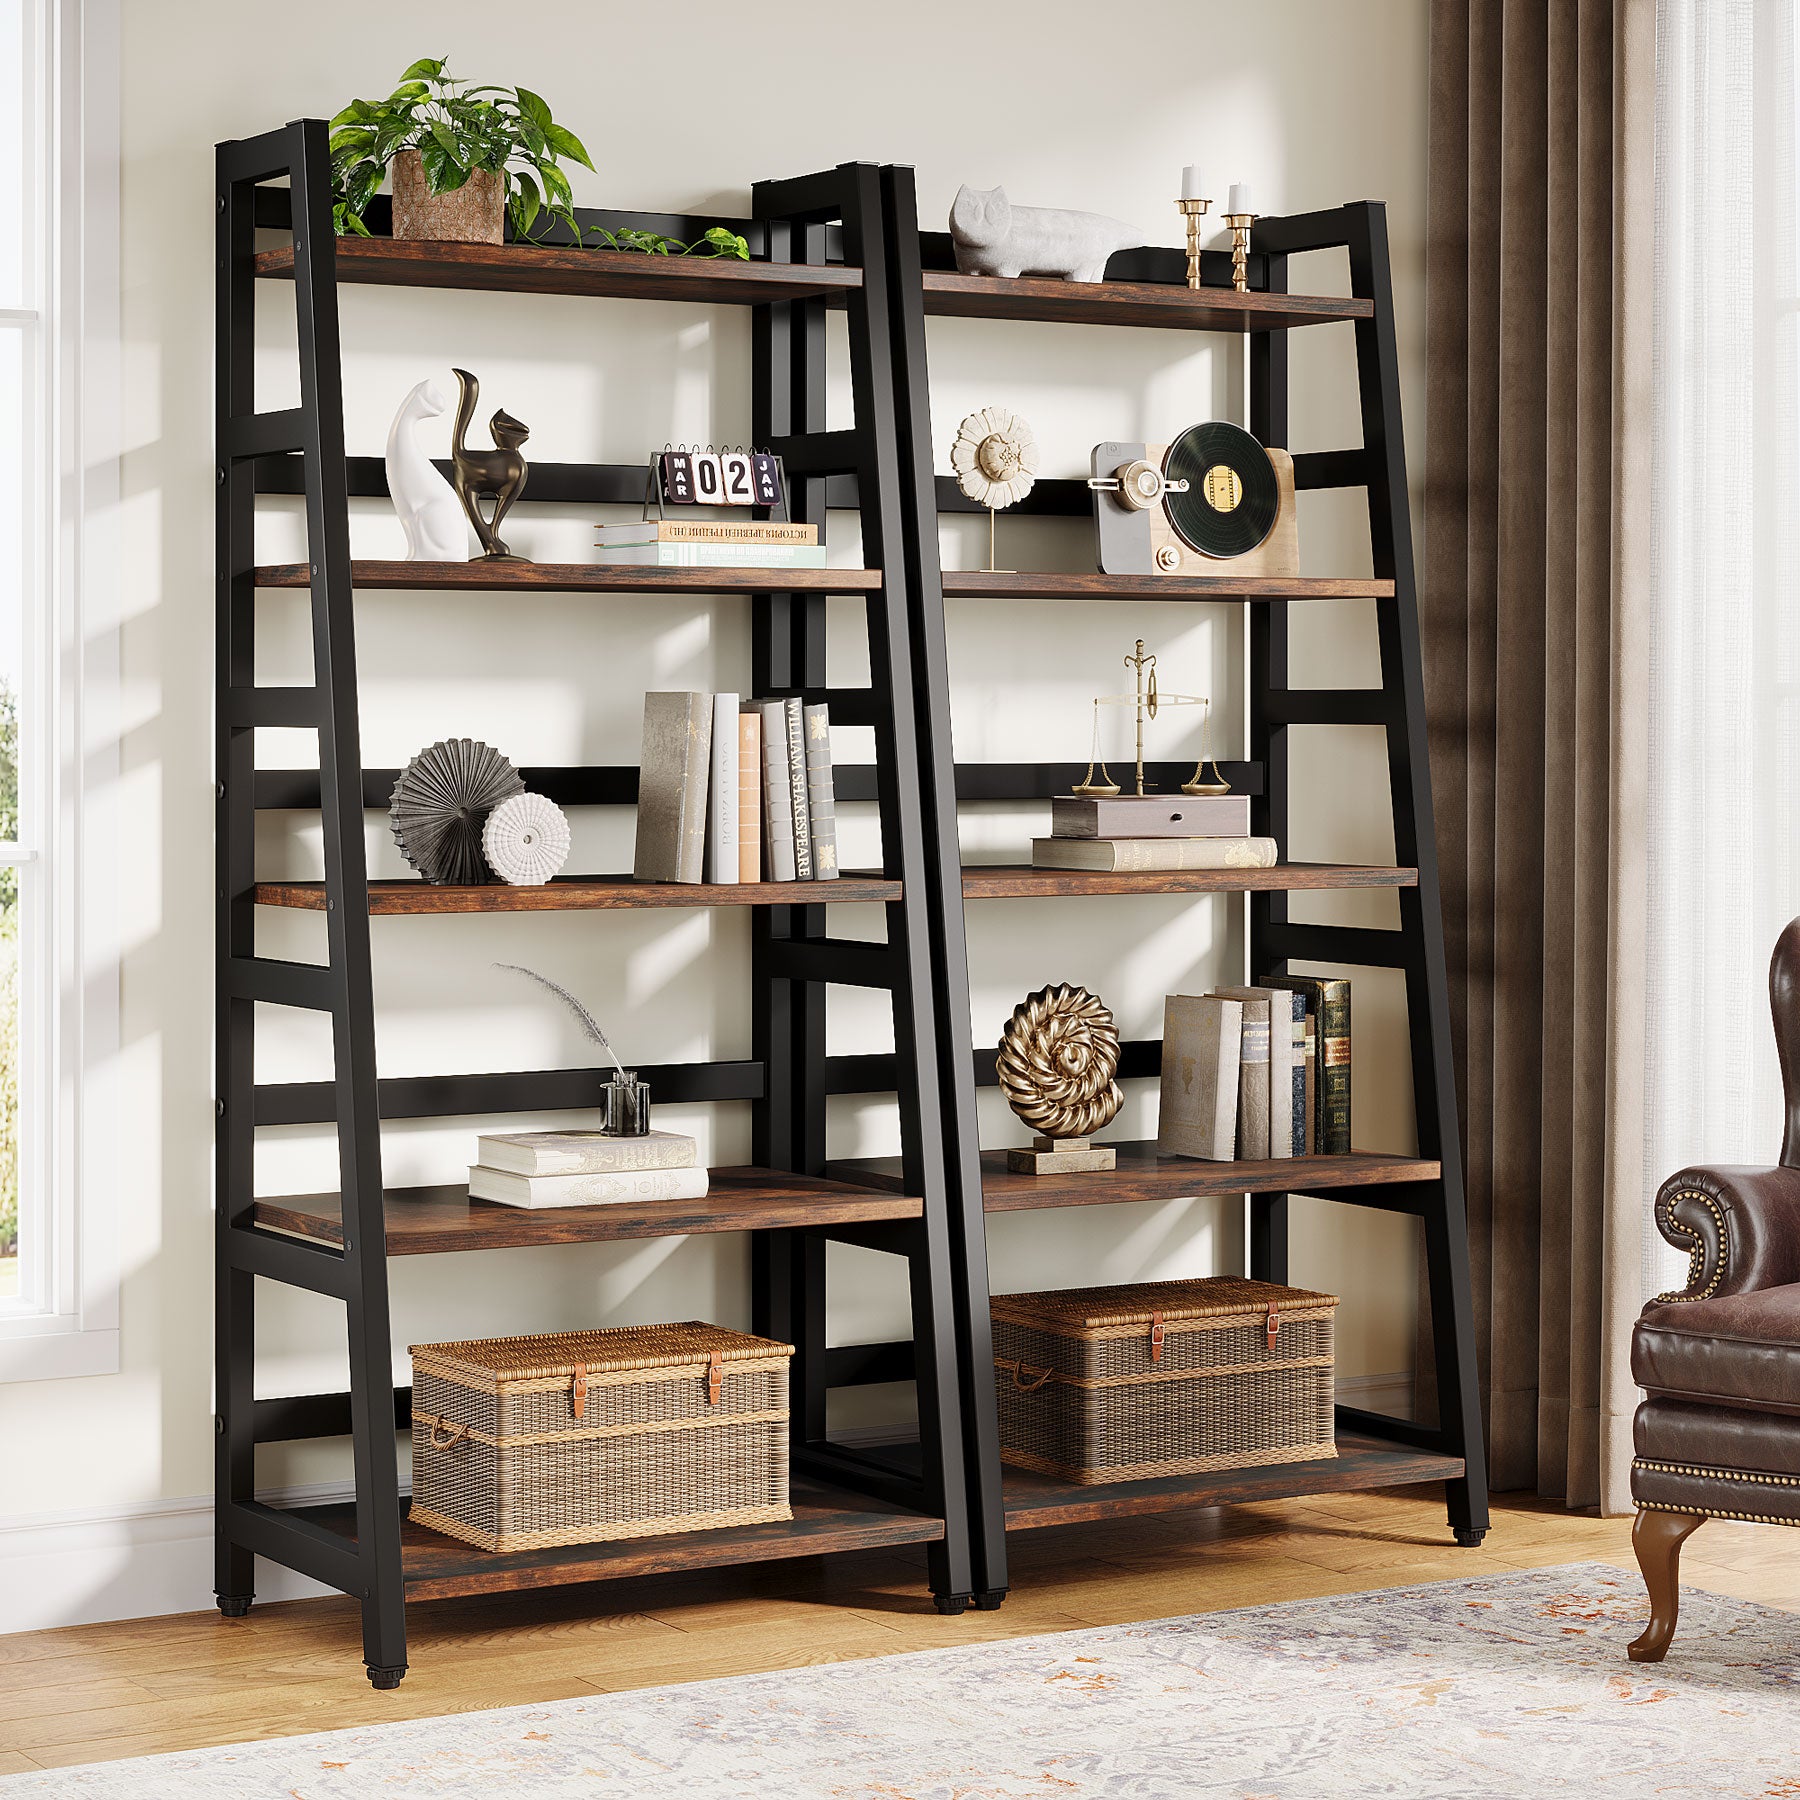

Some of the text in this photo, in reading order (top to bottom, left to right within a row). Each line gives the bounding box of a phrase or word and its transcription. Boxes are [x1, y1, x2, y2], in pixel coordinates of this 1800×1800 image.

[673, 458, 688, 496] MAR
[759, 460, 775, 498] JAN
[766, 529, 807, 539] ИСТОРИЯ
[787, 702, 810, 878] WILLIAM SHAKESPEARE
